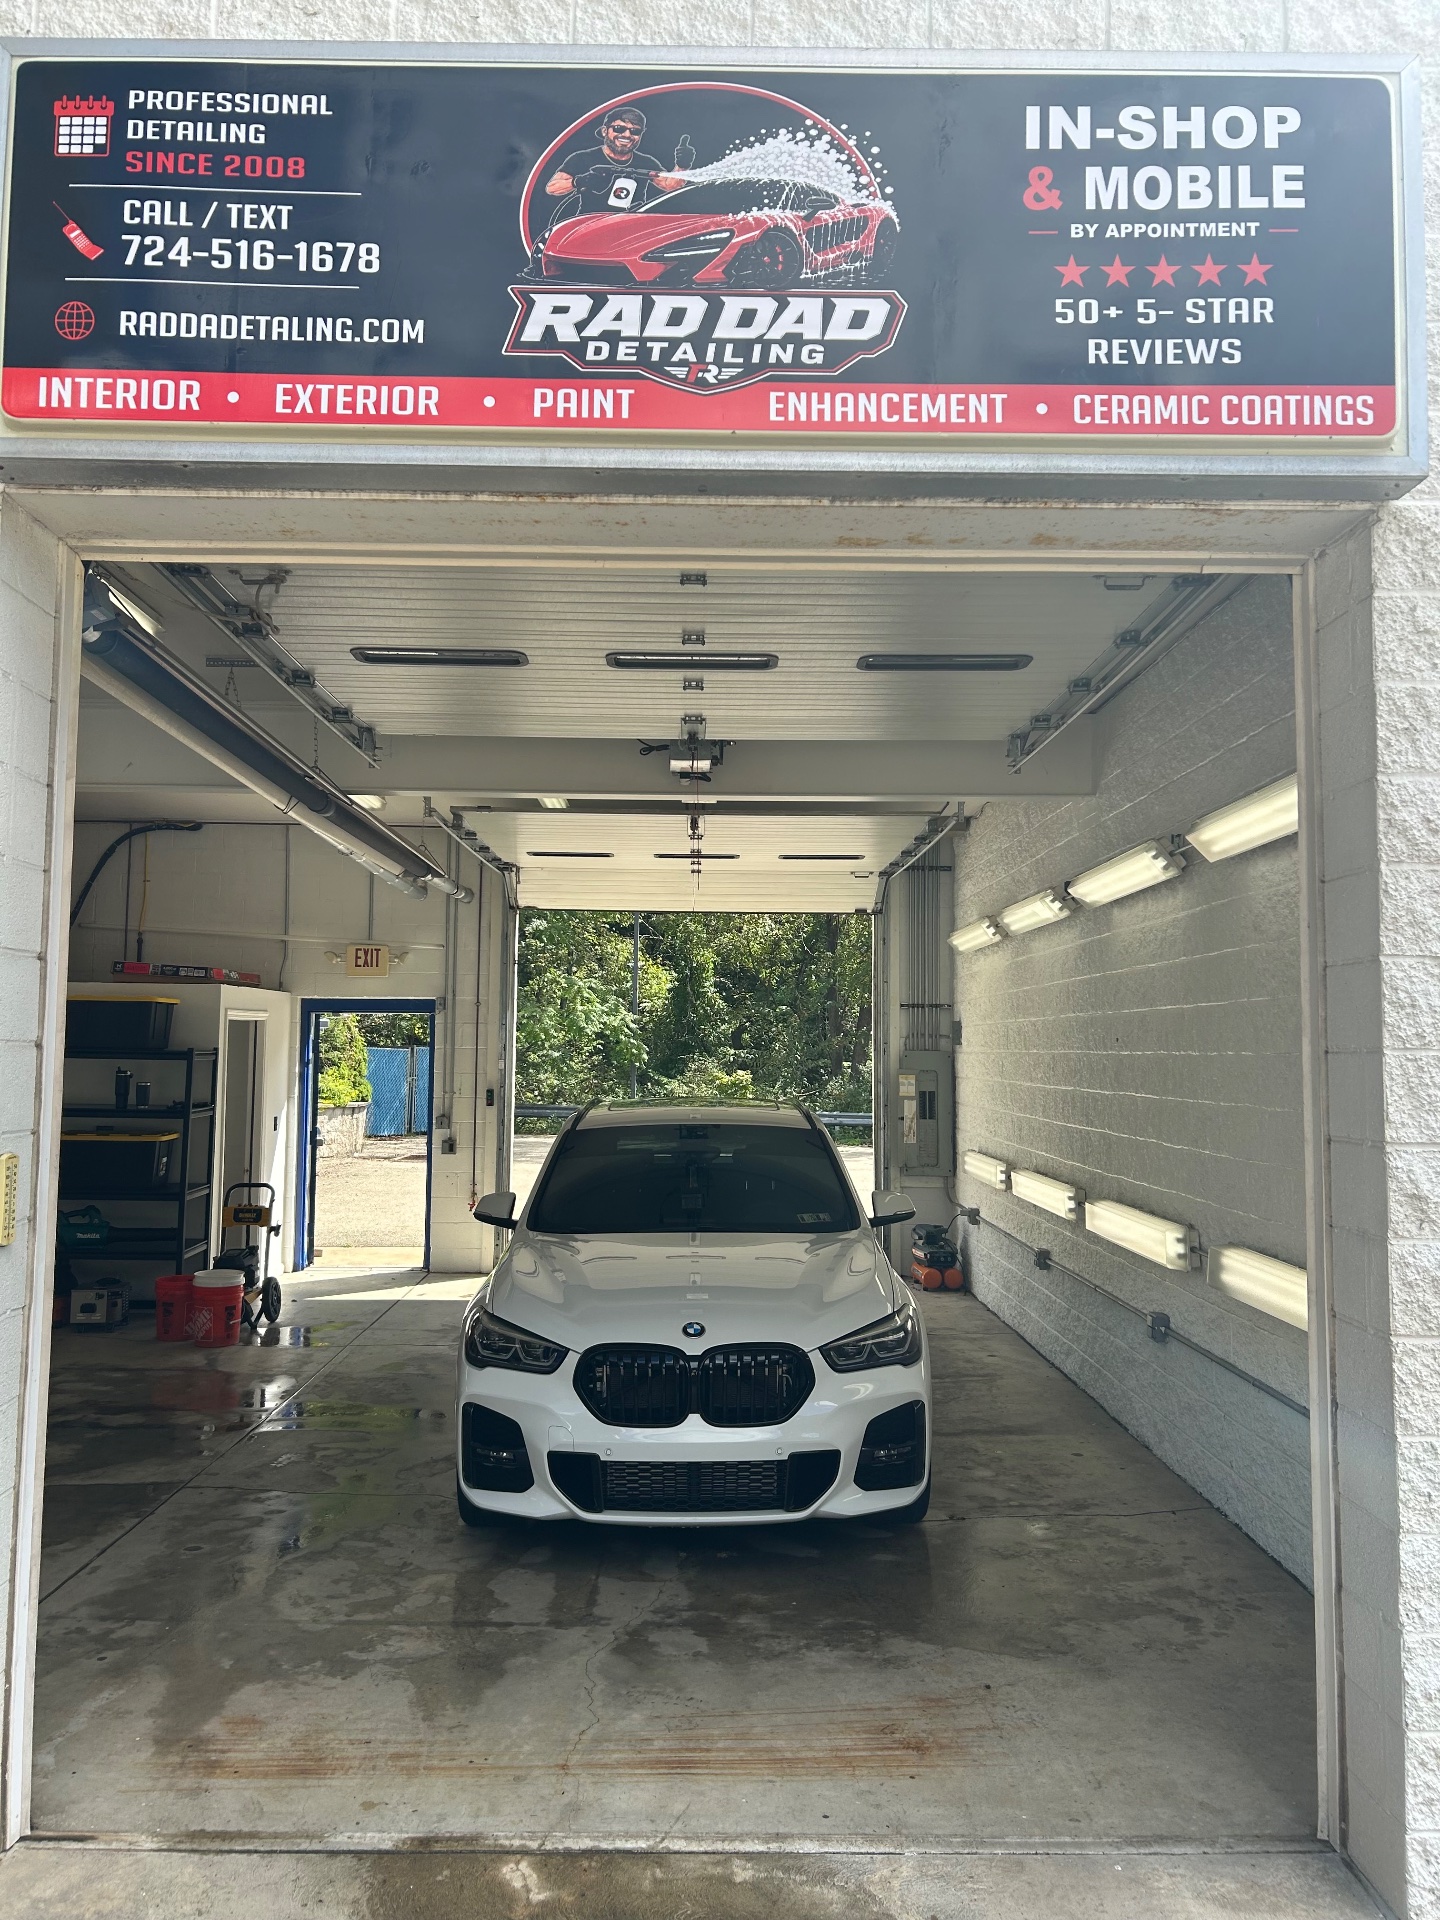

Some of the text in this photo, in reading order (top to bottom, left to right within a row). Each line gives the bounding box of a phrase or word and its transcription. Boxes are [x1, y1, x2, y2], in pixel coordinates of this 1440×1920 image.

[128, 89, 333, 115] PROFESSIONAL
[127, 119, 266, 144] DETAILING
[1025, 105, 1302, 150] IN-SHOP
[126, 151, 306, 179] SINCE 2008
[1022, 164, 1306, 211] & MOBILE
[123, 199, 294, 230] CALL / TEXT
[1070, 222, 1261, 238] BY APPOINTMENT
[121, 234, 380, 274] 724-516-1678
[520, 294, 892, 342] RAD DAD
[1055, 299, 1124, 324] 50+
[1185, 297, 1275, 324] STAR
[119, 311, 425, 344] RADDADETALING.COM
[586, 342, 825, 364] DETAILING
[1088, 338, 1242, 365] REVIEWS
[38, 376, 1374, 426] INTERIOR EXTERIOR PAINT ENHANCEMENT CERAMIC COATINGS
[355, 948, 381, 967] EXIT
